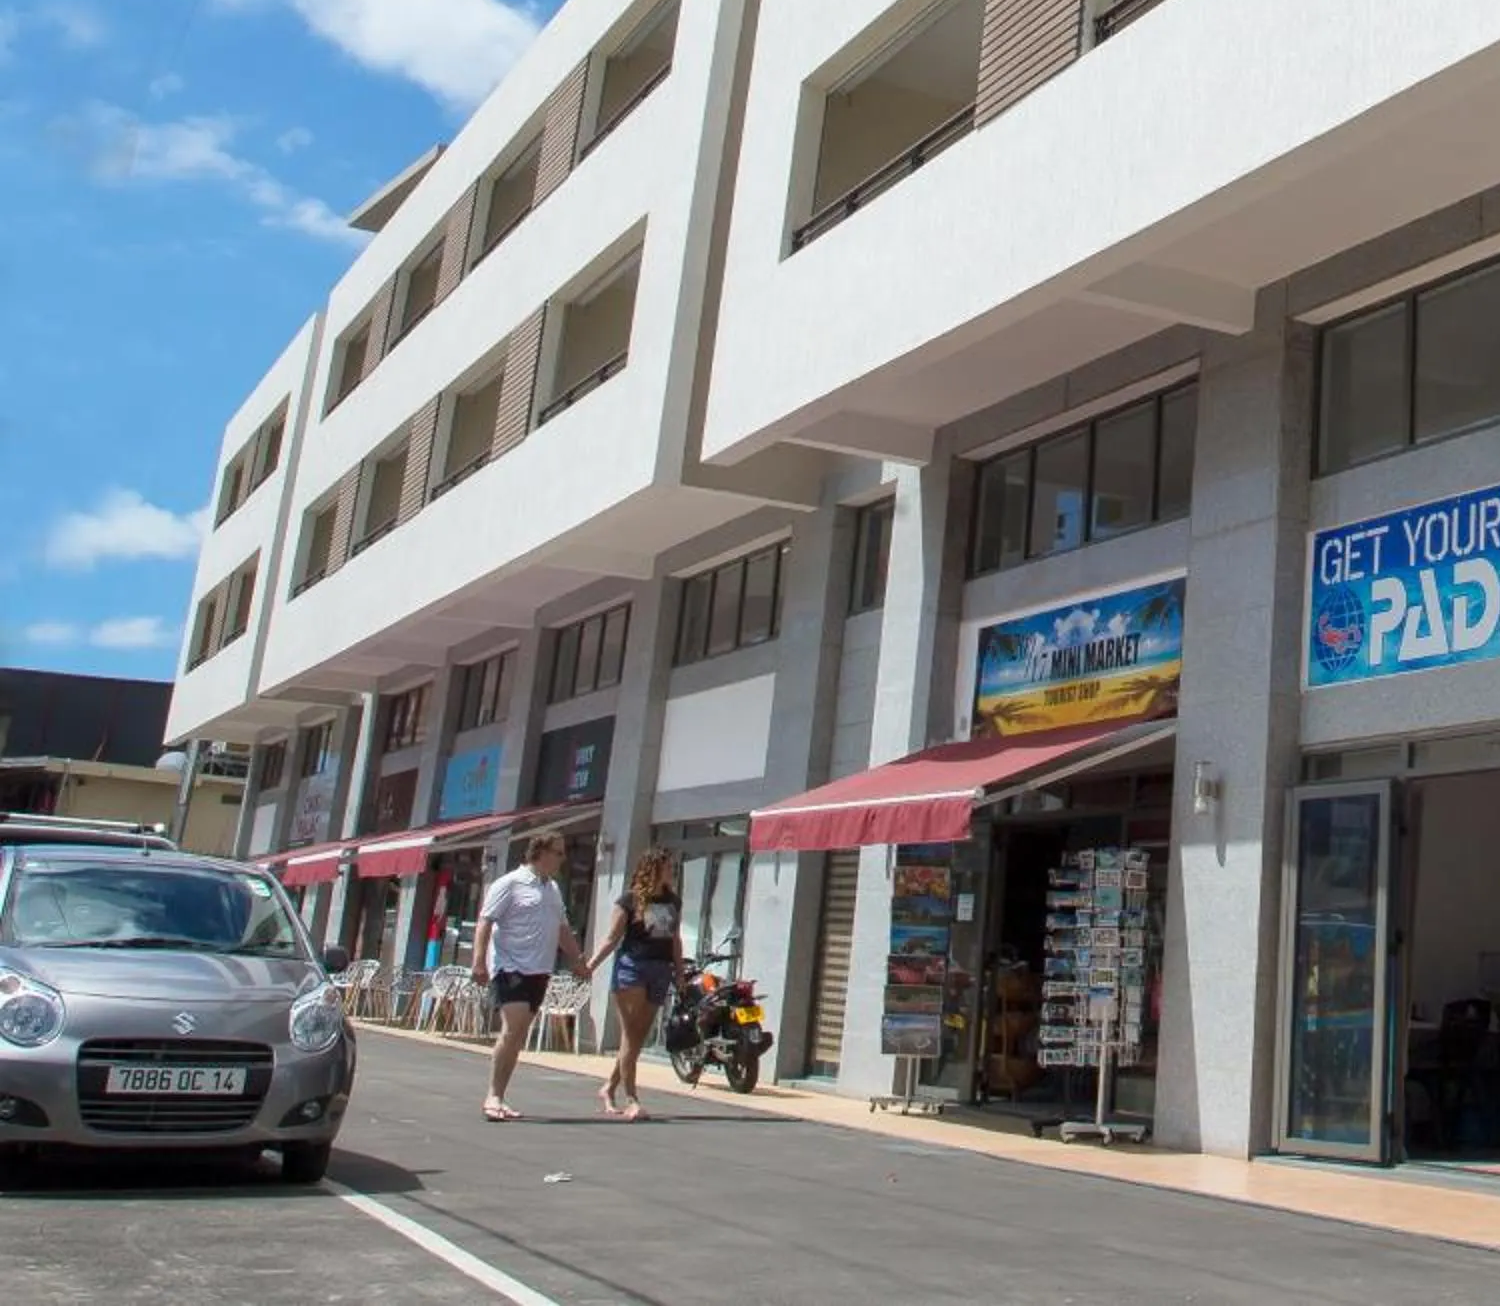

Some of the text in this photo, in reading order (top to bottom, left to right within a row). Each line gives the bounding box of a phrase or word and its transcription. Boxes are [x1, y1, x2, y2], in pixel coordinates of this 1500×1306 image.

[1320, 527, 1388, 585] GET
[1050, 645, 1081, 680] MINI
[1083, 632, 1141, 674] MARKET
[120, 1069, 173, 1090] 7886
[213, 1070, 234, 1091] 14
